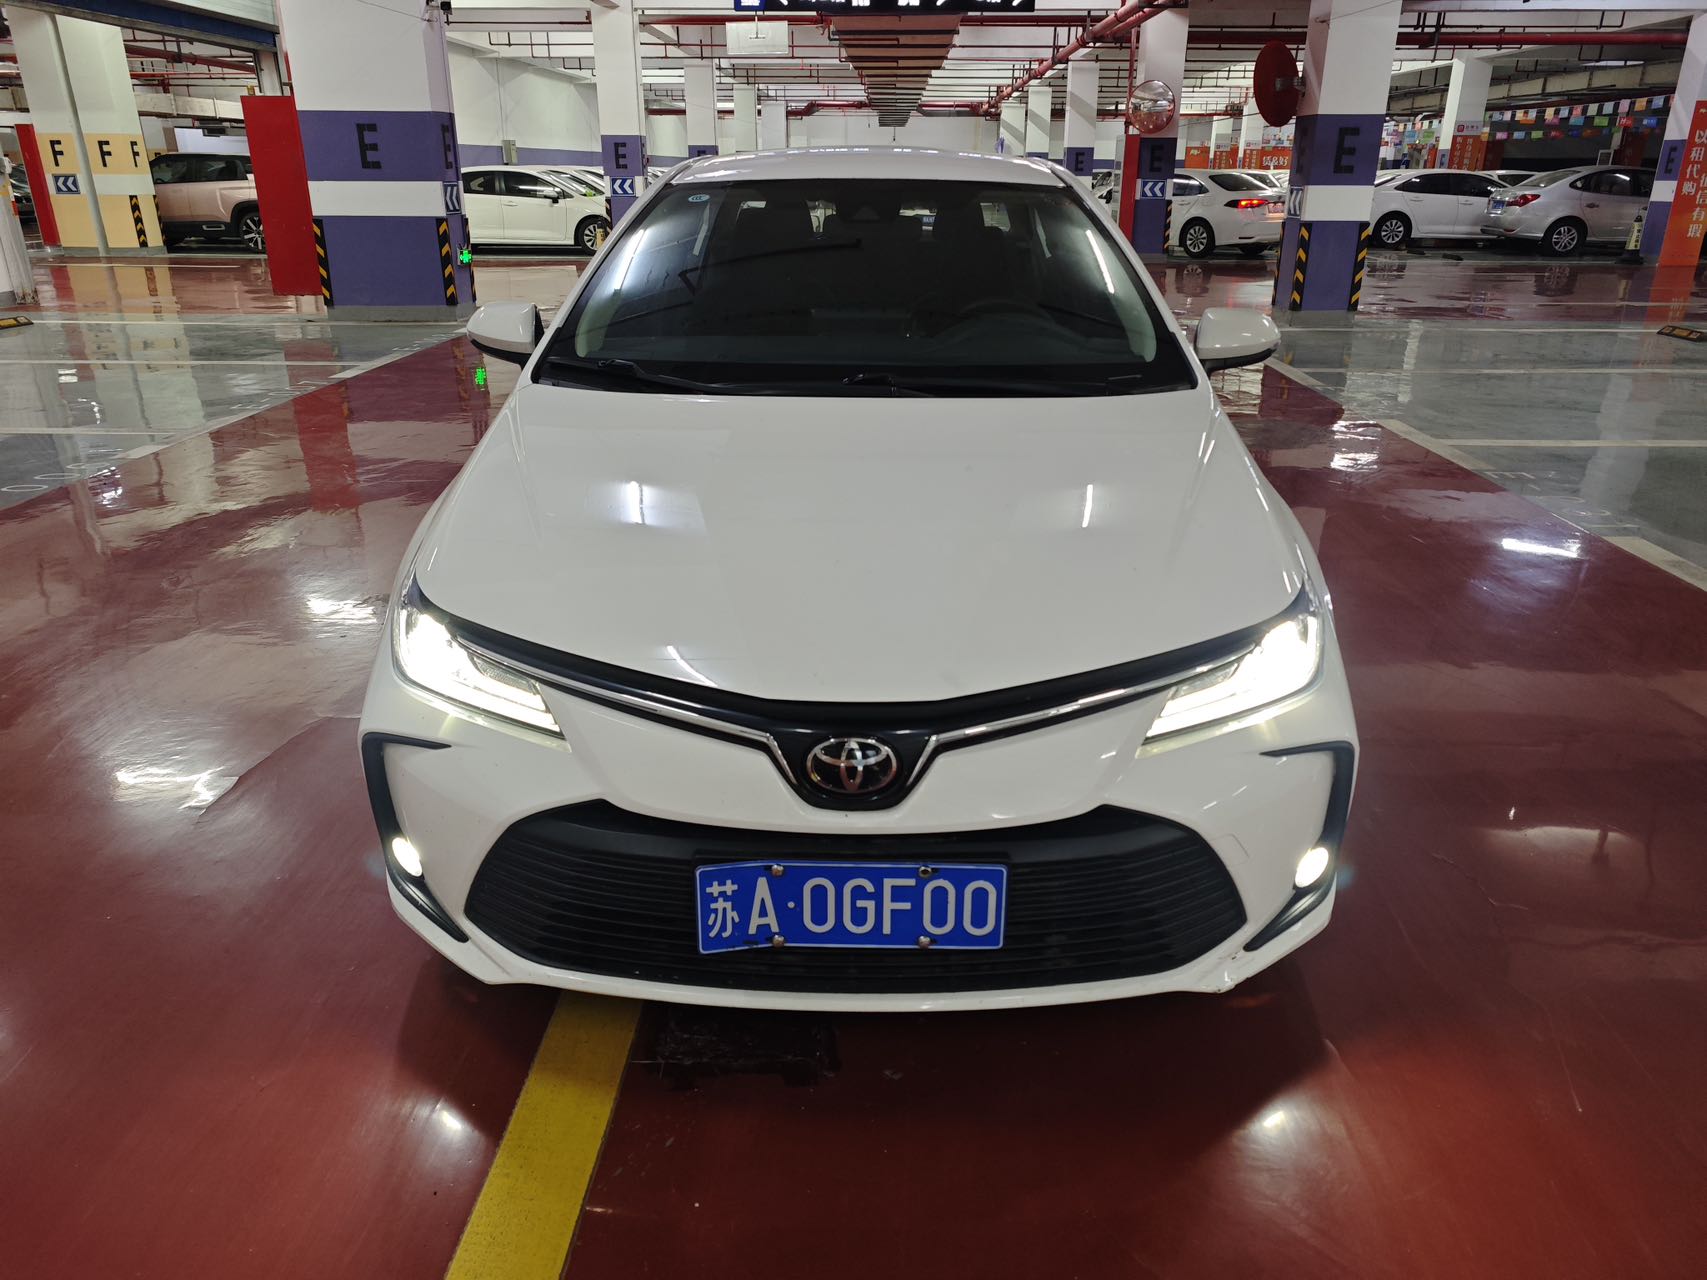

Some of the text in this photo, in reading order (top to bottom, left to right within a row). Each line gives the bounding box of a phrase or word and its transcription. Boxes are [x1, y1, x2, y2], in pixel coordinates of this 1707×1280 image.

[49, 140, 64, 167] F
[97, 140, 112, 167] F
[130, 140, 140, 167] F
[356, 123, 382, 169] E
[441, 124, 453, 169] E
[613, 142, 628, 169] E
[1150, 144, 1164, 172] E
[1333, 126, 1360, 173] E
[1664, 145, 1678, 174] E
[1074, 152, 1085, 171] E
